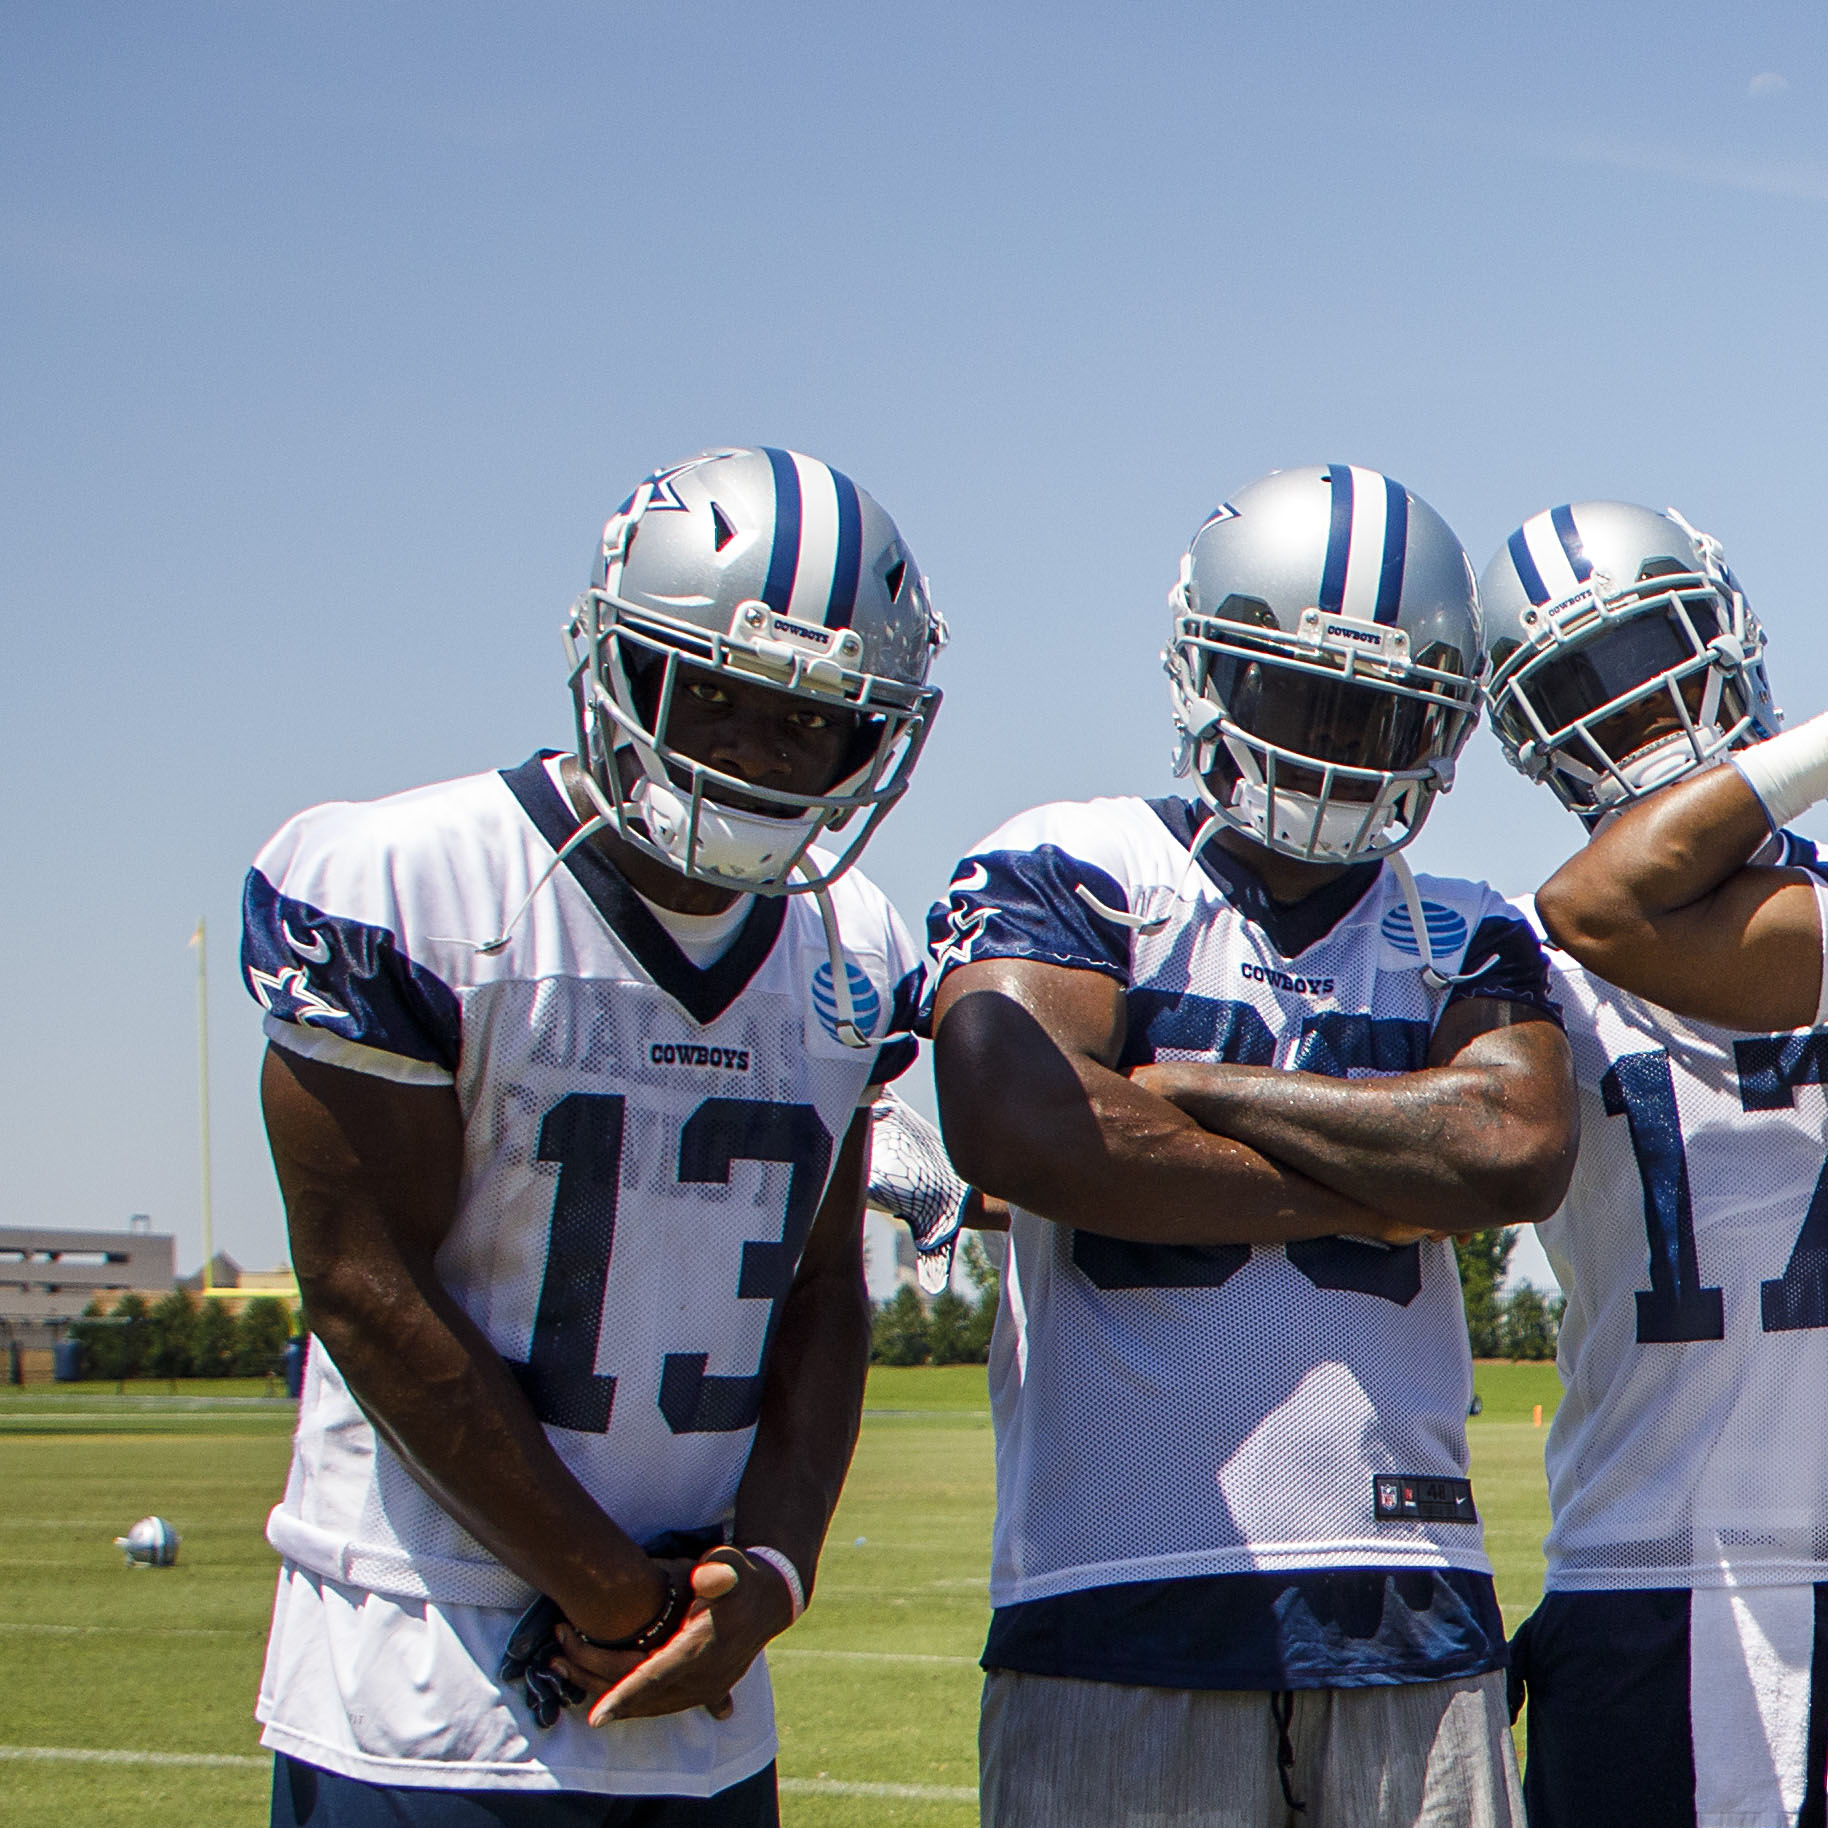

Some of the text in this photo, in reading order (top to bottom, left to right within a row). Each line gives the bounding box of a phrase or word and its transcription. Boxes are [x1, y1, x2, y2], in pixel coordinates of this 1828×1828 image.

[1549, 589, 1593, 617] COWBOYS
[774, 619, 830, 645] COWBOYS
[1327, 624, 1382, 645] COWBOYS
[1240, 961, 1335, 996] COWBOYS
[650, 1043, 750, 1071] COWBOYS
[506, 1092, 833, 1436] 13
